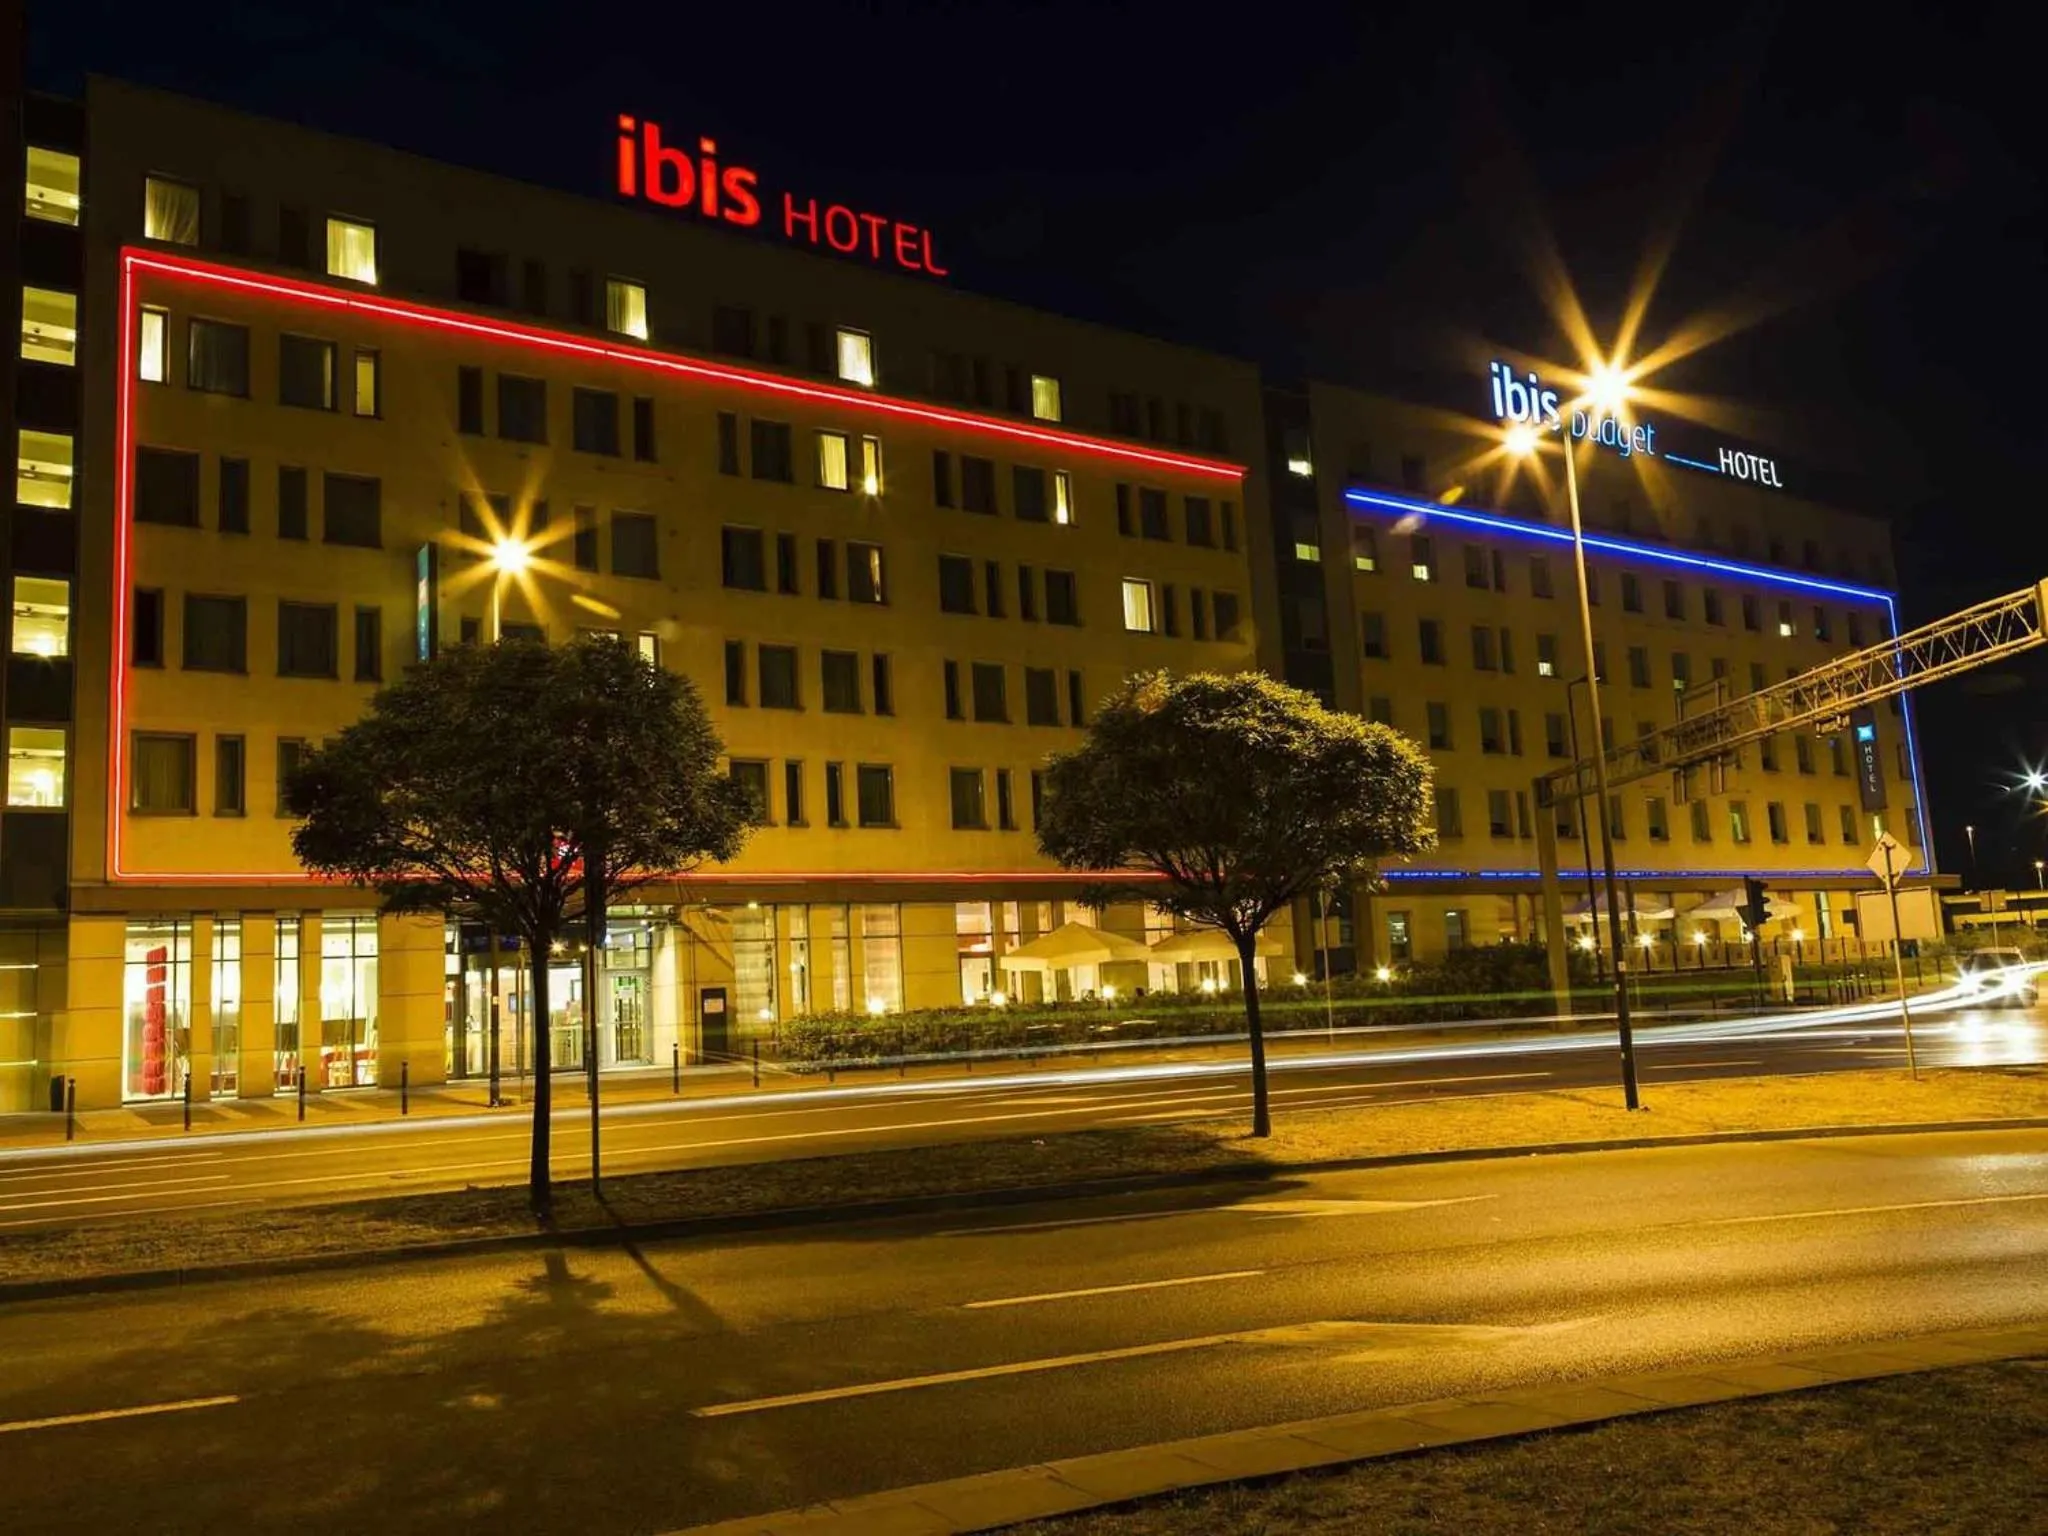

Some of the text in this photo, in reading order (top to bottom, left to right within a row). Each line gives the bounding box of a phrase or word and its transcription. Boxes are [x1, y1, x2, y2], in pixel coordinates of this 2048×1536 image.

[618, 113, 948, 276] ibis HOTEL
[1490, 361, 1562, 431] ibis
[1718, 447, 1783, 488] HOTEL
[1863, 745, 1877, 792] HOTEL
